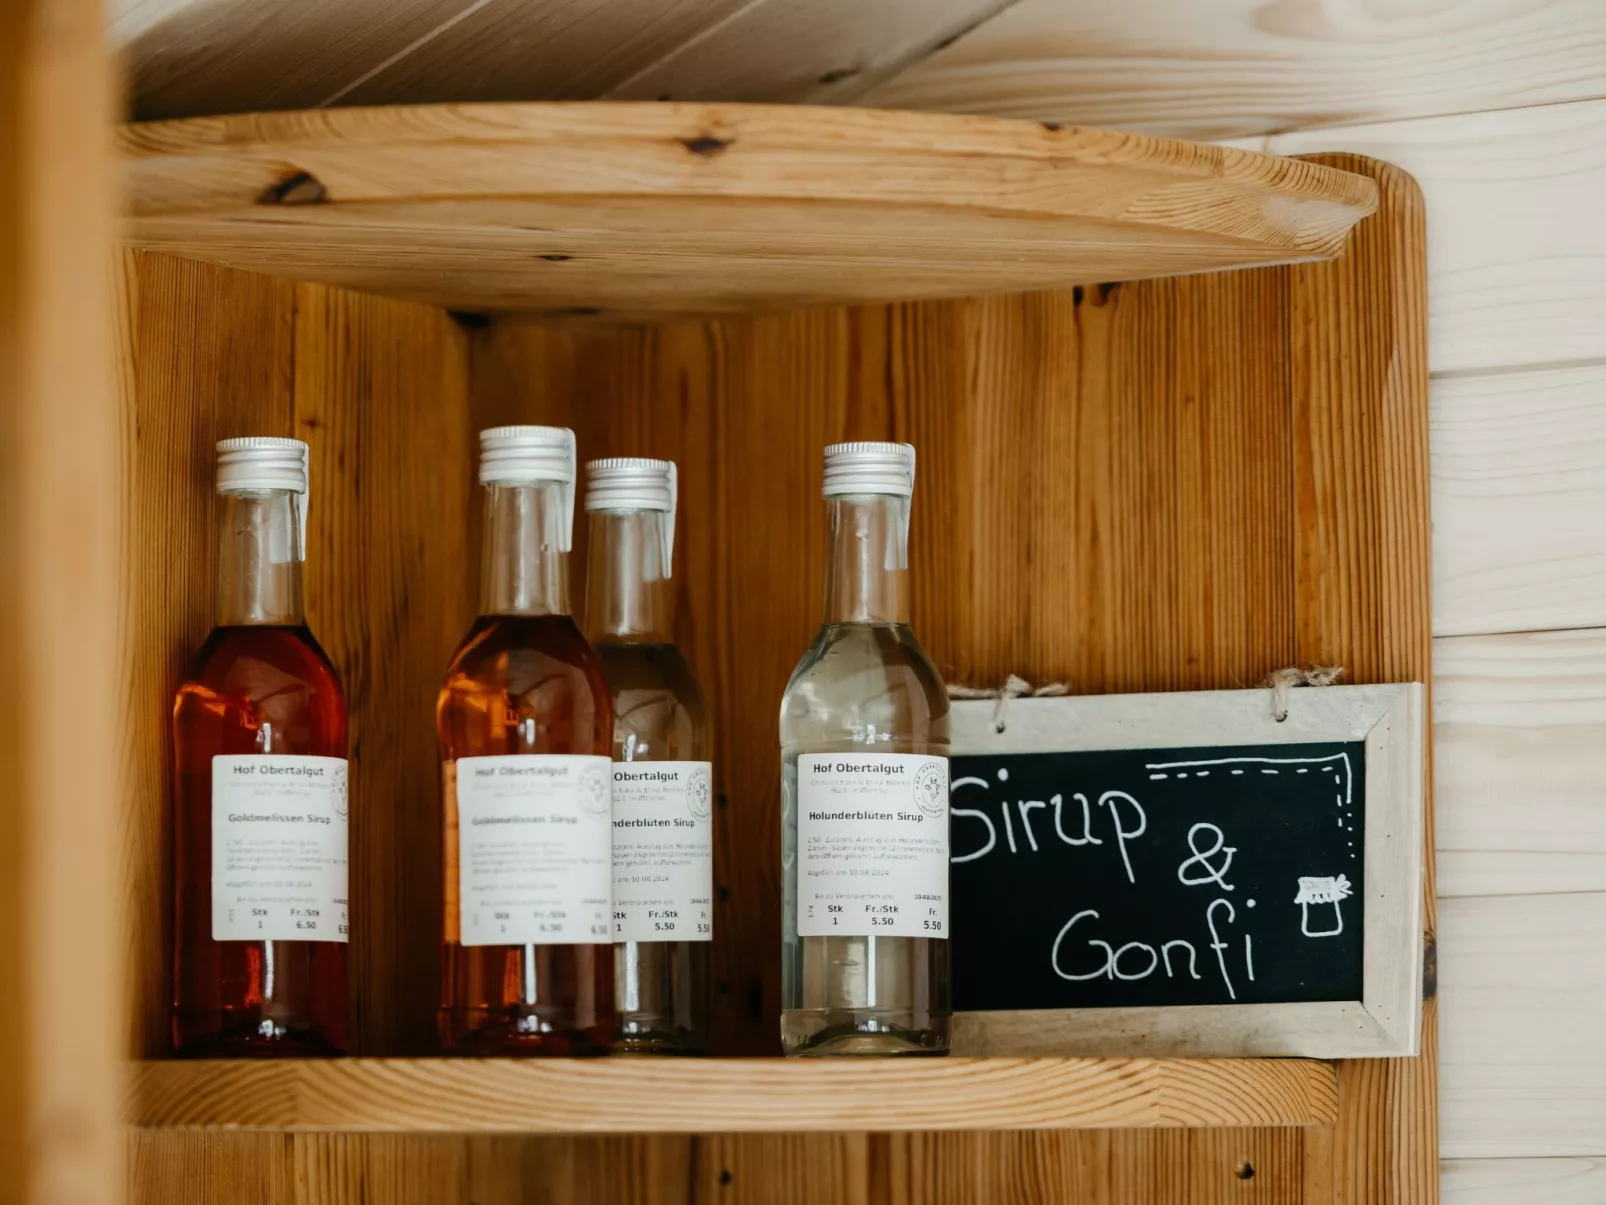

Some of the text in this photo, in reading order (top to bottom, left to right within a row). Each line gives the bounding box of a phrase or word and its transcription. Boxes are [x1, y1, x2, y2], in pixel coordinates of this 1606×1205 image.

[233, 764, 324, 777] Hof Obertalgut
[475, 766, 568, 777] Hof Obertalgut
[813, 763, 905, 775] Hof Obertalgut
[613, 771, 679, 783] Obertalgut
[228, 813, 332, 825] Goldmelissen Sirup
[897, 811, 924, 823] Sirup
[673, 818, 695, 829] Sirup
[951, 767, 1237, 891] Sirup &
[251, 908, 268, 916] Stk
[648, 910, 679, 919] Fr./Stk
[827, 904, 938, 916] Stk Fr./Stk Fr.
[257, 920, 263, 929] 1
[296, 920, 317, 929] 6.50
[616, 923, 622, 932] 1
[654, 922, 675, 931] 5.50
[832, 917, 942, 930] 1 5.50 5.50
[1052, 898, 1255, 1000] Gonfi
